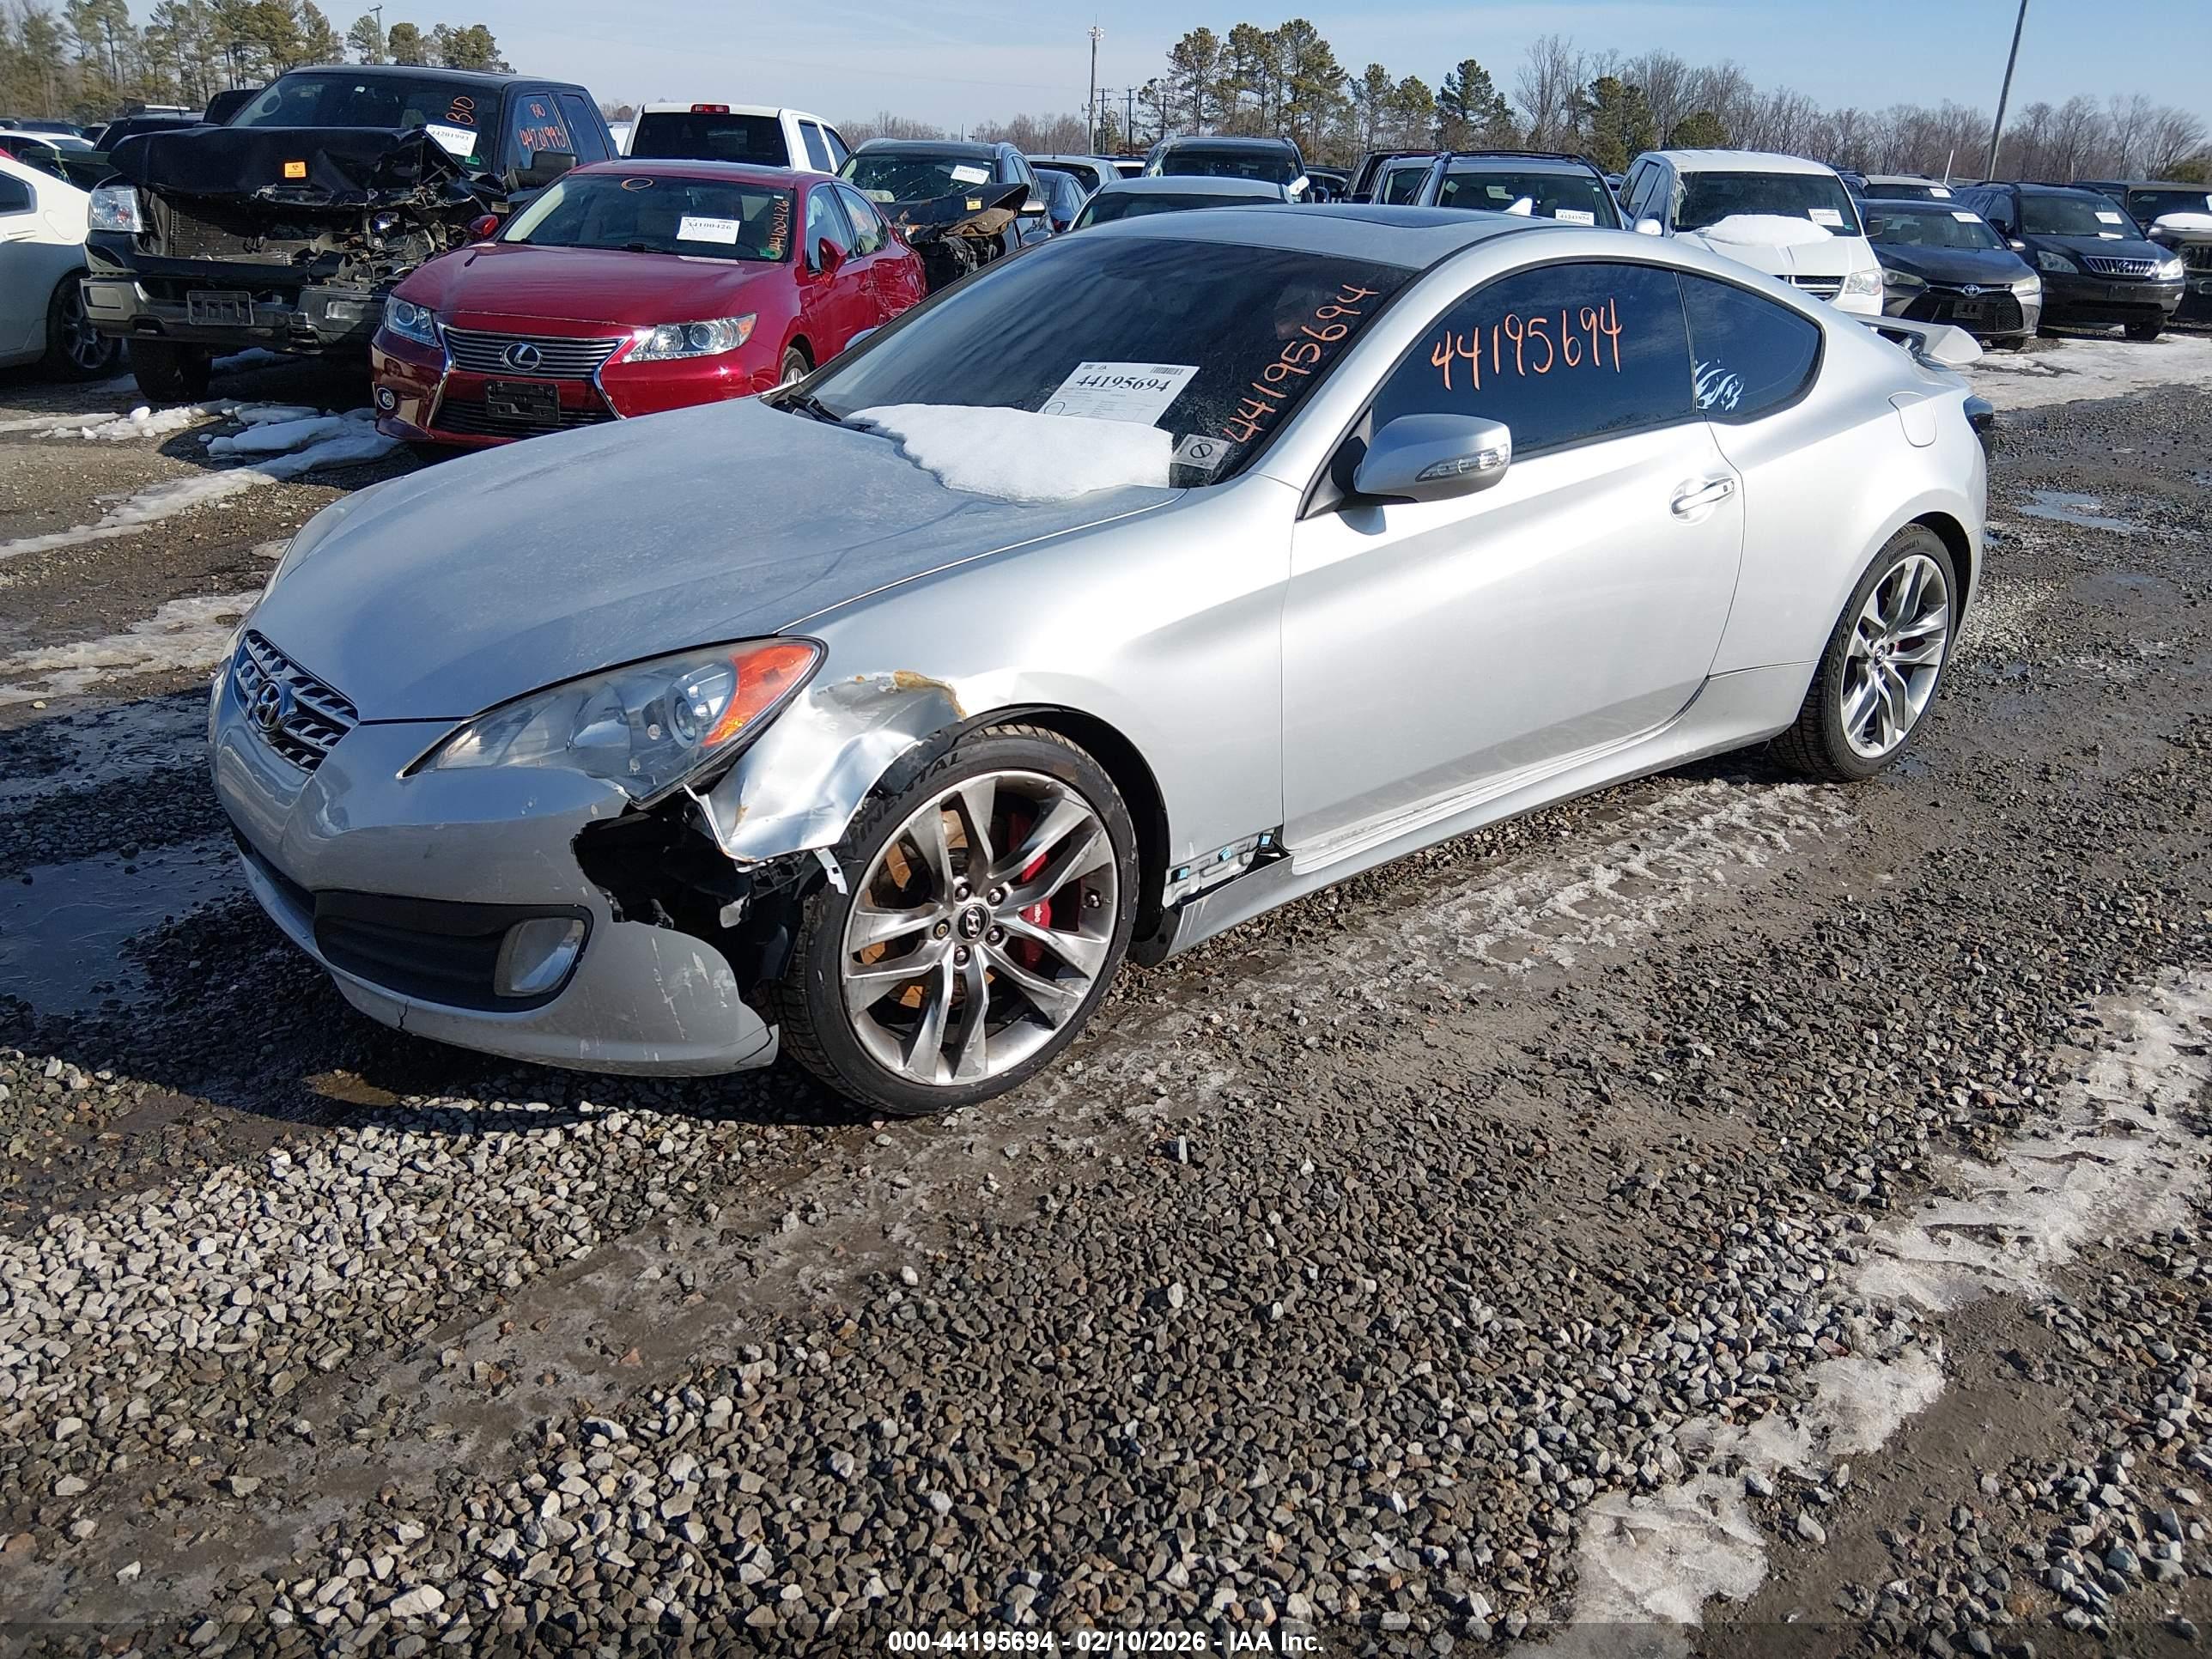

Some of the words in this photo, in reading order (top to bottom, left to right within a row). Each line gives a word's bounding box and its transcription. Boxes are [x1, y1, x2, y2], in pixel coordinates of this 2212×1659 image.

[1076, 374, 1172, 392] 44195694
[1224, 284, 1381, 443] 44195694
[1431, 297, 1623, 391] 44195694
